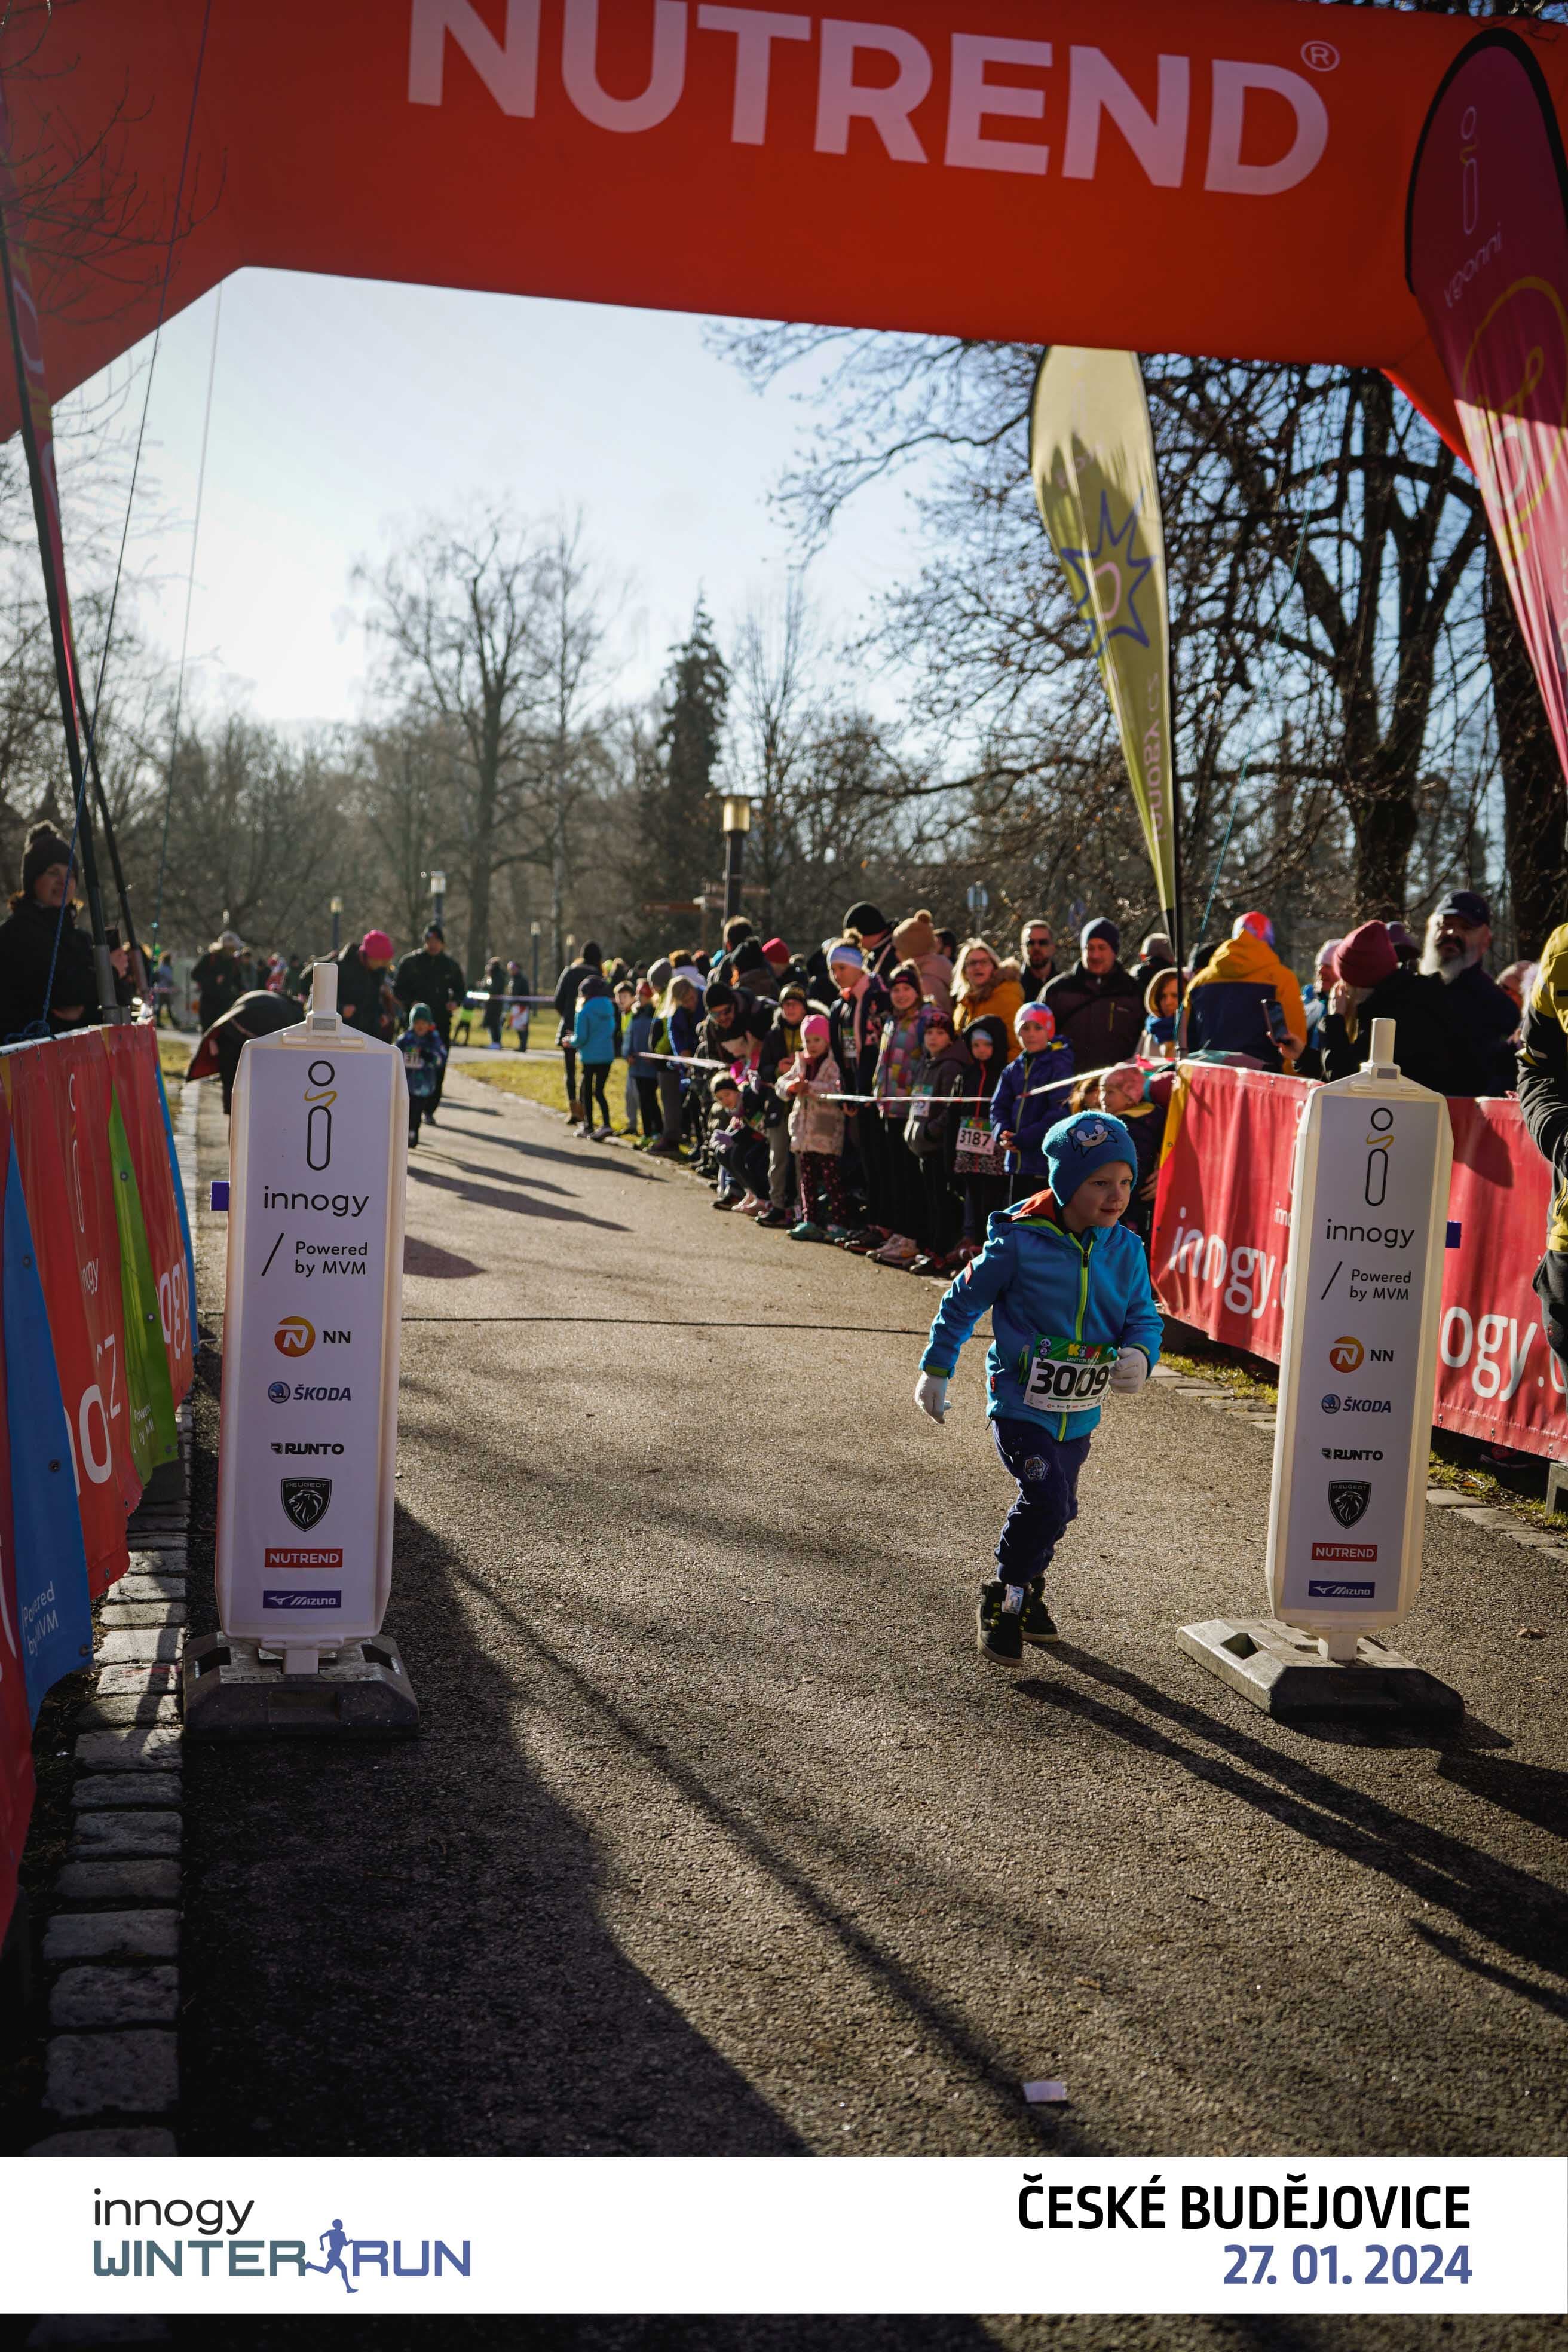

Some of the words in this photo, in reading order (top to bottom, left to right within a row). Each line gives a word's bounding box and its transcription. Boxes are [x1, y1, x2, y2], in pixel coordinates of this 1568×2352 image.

[960, 1129, 990, 1146] 3187
[263, 1186, 369, 1217] innogy
[1326, 1219, 1415, 1248] innogy
[296, 1241, 368, 1257] Powered
[295, 1260, 315, 1278] by
[322, 1261, 366, 1275] MVM
[1352, 1269, 1411, 1284] Powered
[1350, 1286, 1367, 1301] by
[1373, 1287, 1409, 1301] MVM
[323, 1331, 351, 1345] NN
[1370, 1349, 1394, 1362] NN
[1030, 1361, 1110, 1397] 3009
[293, 1384, 352, 1401] ŠKODA
[1343, 1396, 1392, 1413] ŠKODA
[284, 1443, 345, 1455] RUNTO
[1333, 1449, 1383, 1462] RUNTO
[270, 1552, 339, 1564] NUTREND
[1316, 1546, 1374, 1558] NUTREND
